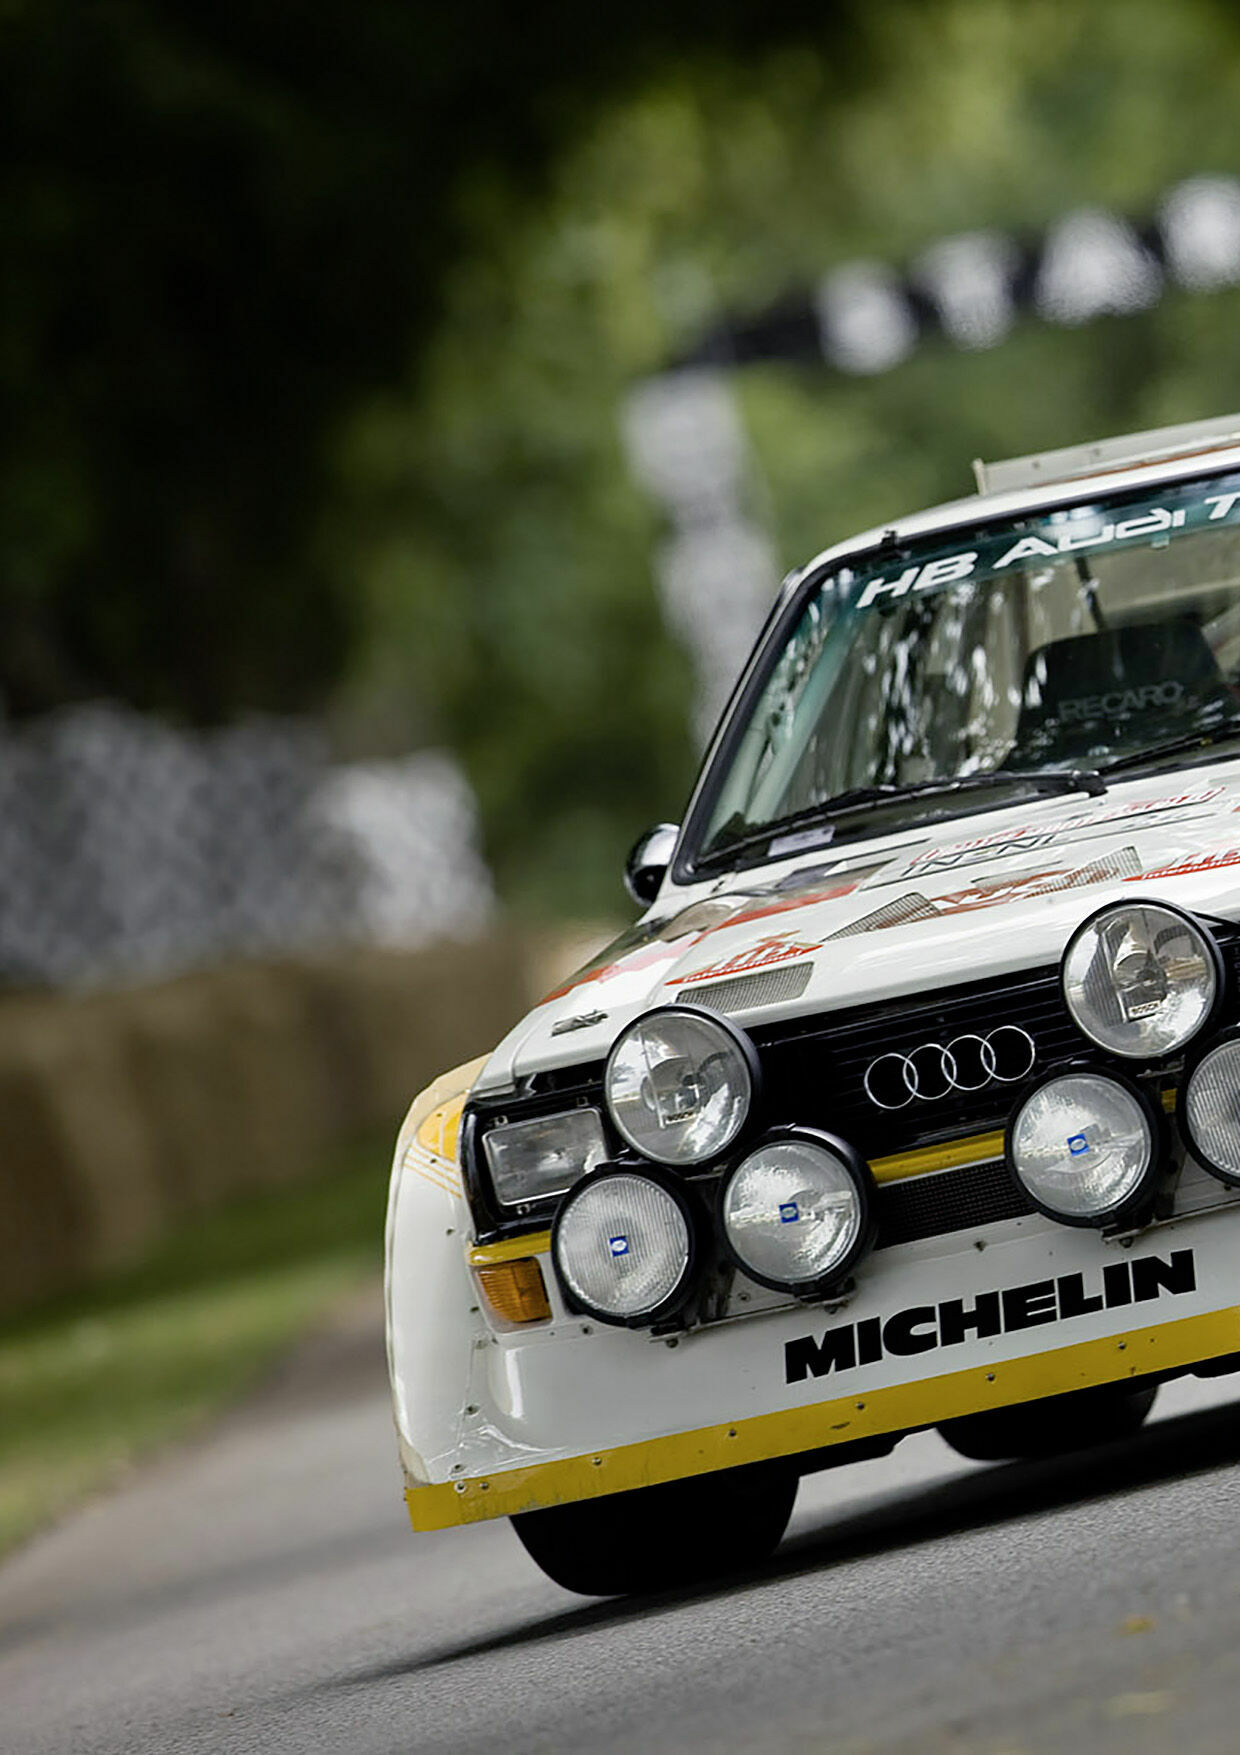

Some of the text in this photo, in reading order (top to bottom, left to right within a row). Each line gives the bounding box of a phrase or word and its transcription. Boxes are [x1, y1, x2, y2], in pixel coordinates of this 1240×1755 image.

[855, 551, 978, 609] HB
[1058, 681, 1184, 722] RECARO
[784, 1248, 1197, 1385] MICHELIN
